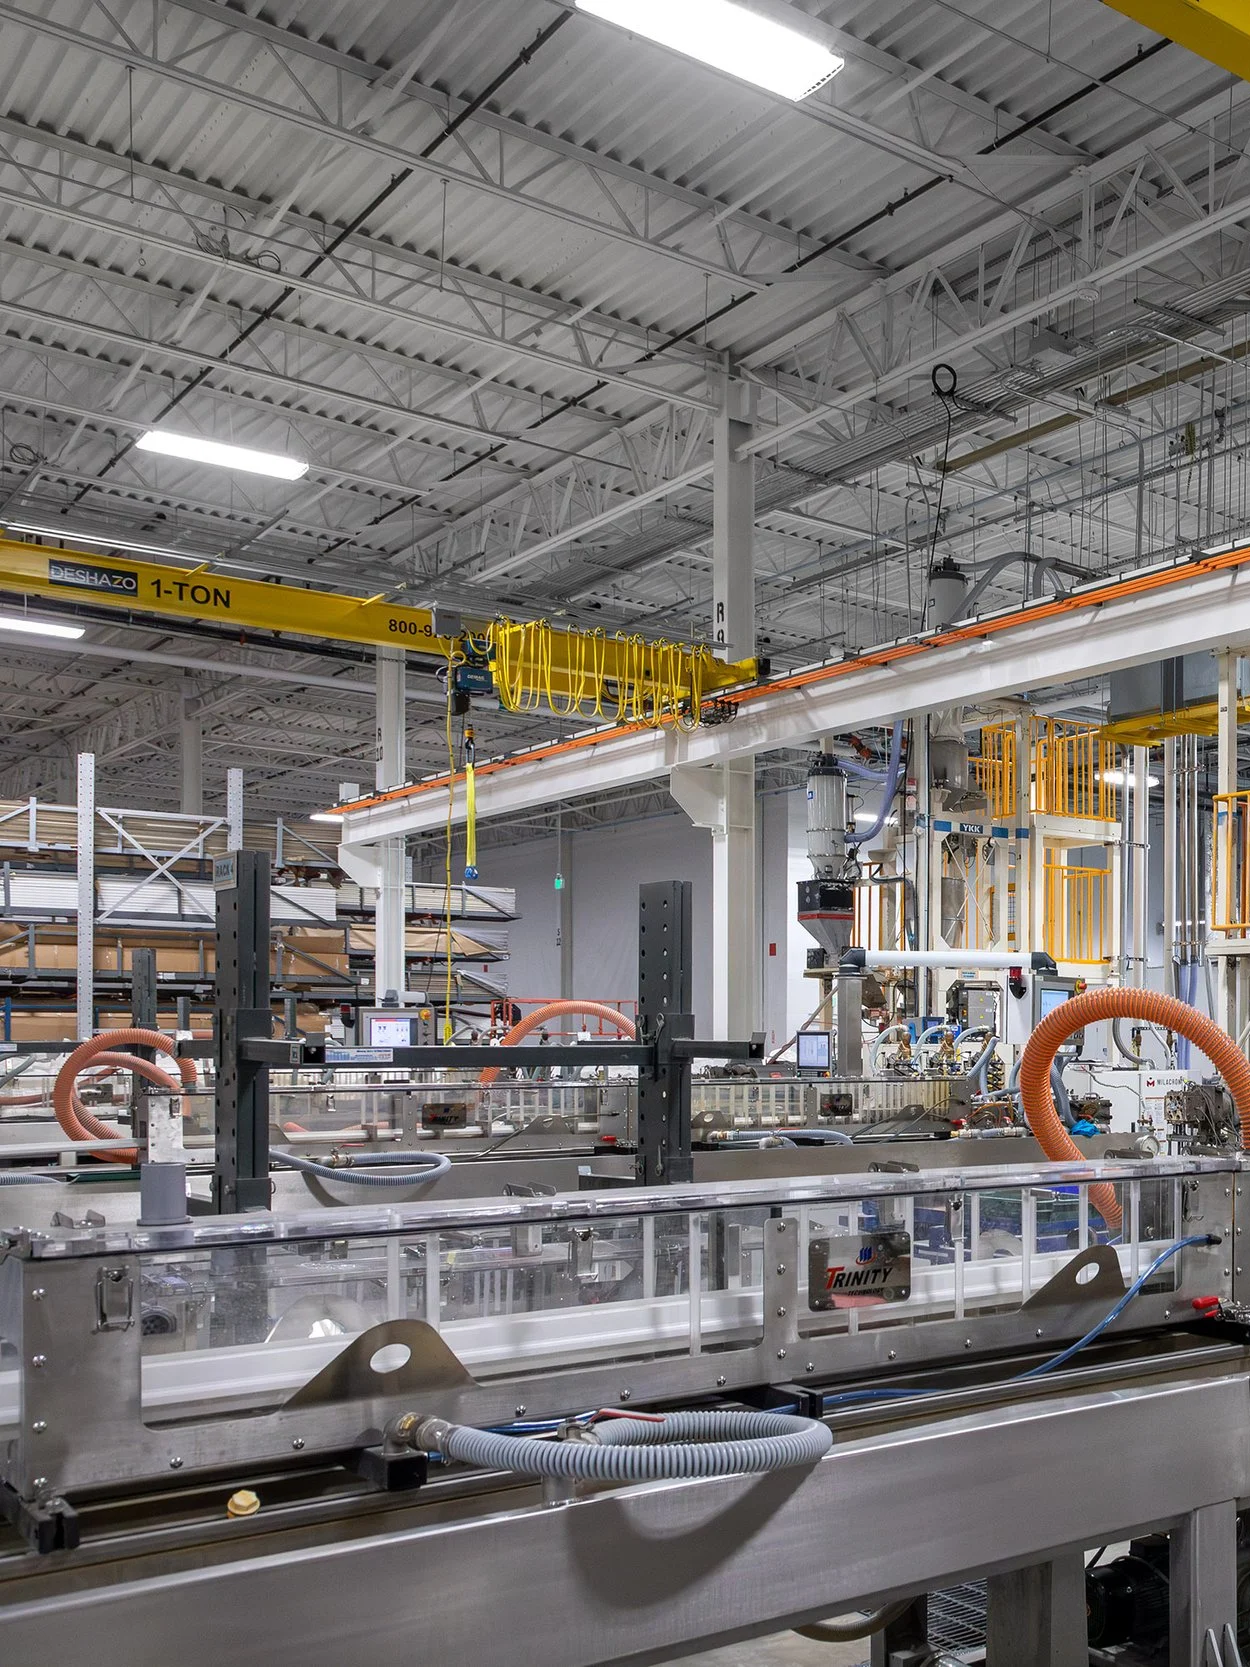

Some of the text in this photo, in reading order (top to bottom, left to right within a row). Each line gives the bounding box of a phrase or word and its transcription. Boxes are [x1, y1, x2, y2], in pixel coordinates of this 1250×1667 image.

[51, 565, 231, 609] DESHAZO 1-TON
[717, 601, 725, 623] R
[963, 824, 980, 832] YKK
[825, 1266, 893, 1290] TRINITY
